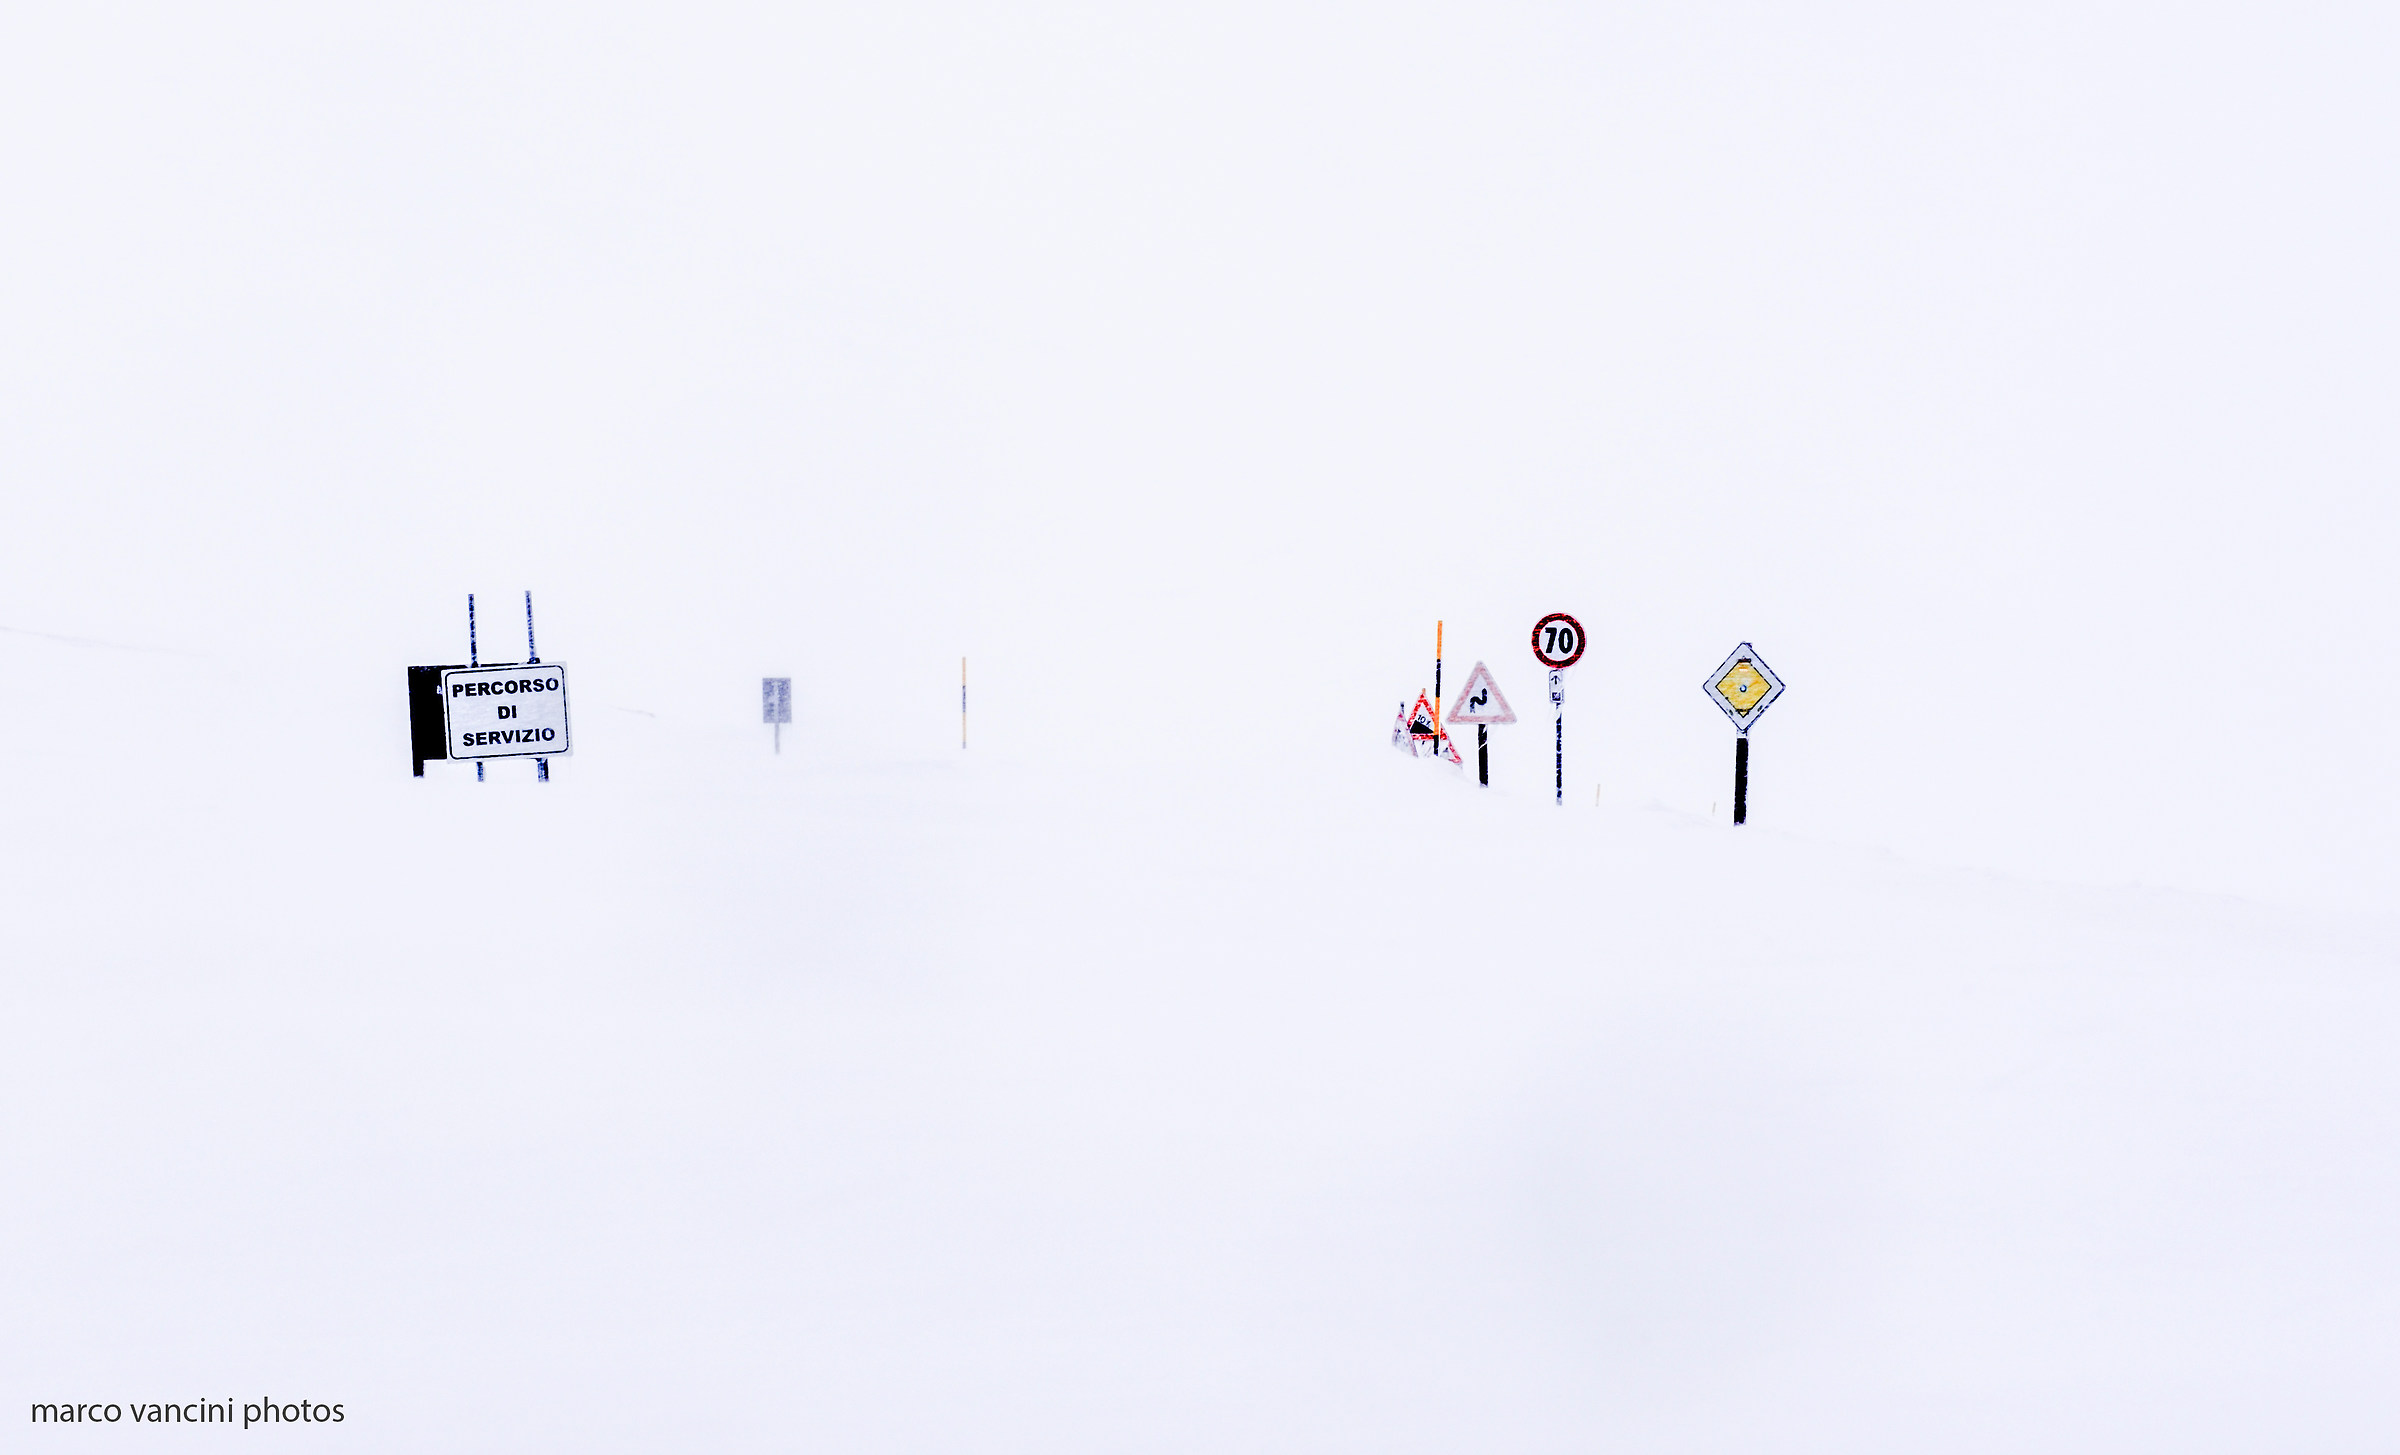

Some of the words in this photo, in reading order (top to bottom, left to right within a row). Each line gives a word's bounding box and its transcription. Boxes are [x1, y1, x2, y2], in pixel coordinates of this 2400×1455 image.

[1545, 626, 1574, 654] 70
[452, 677, 559, 698] PERCORSO
[497, 704, 517, 720] DI
[462, 727, 555, 747] SERVIZIO
